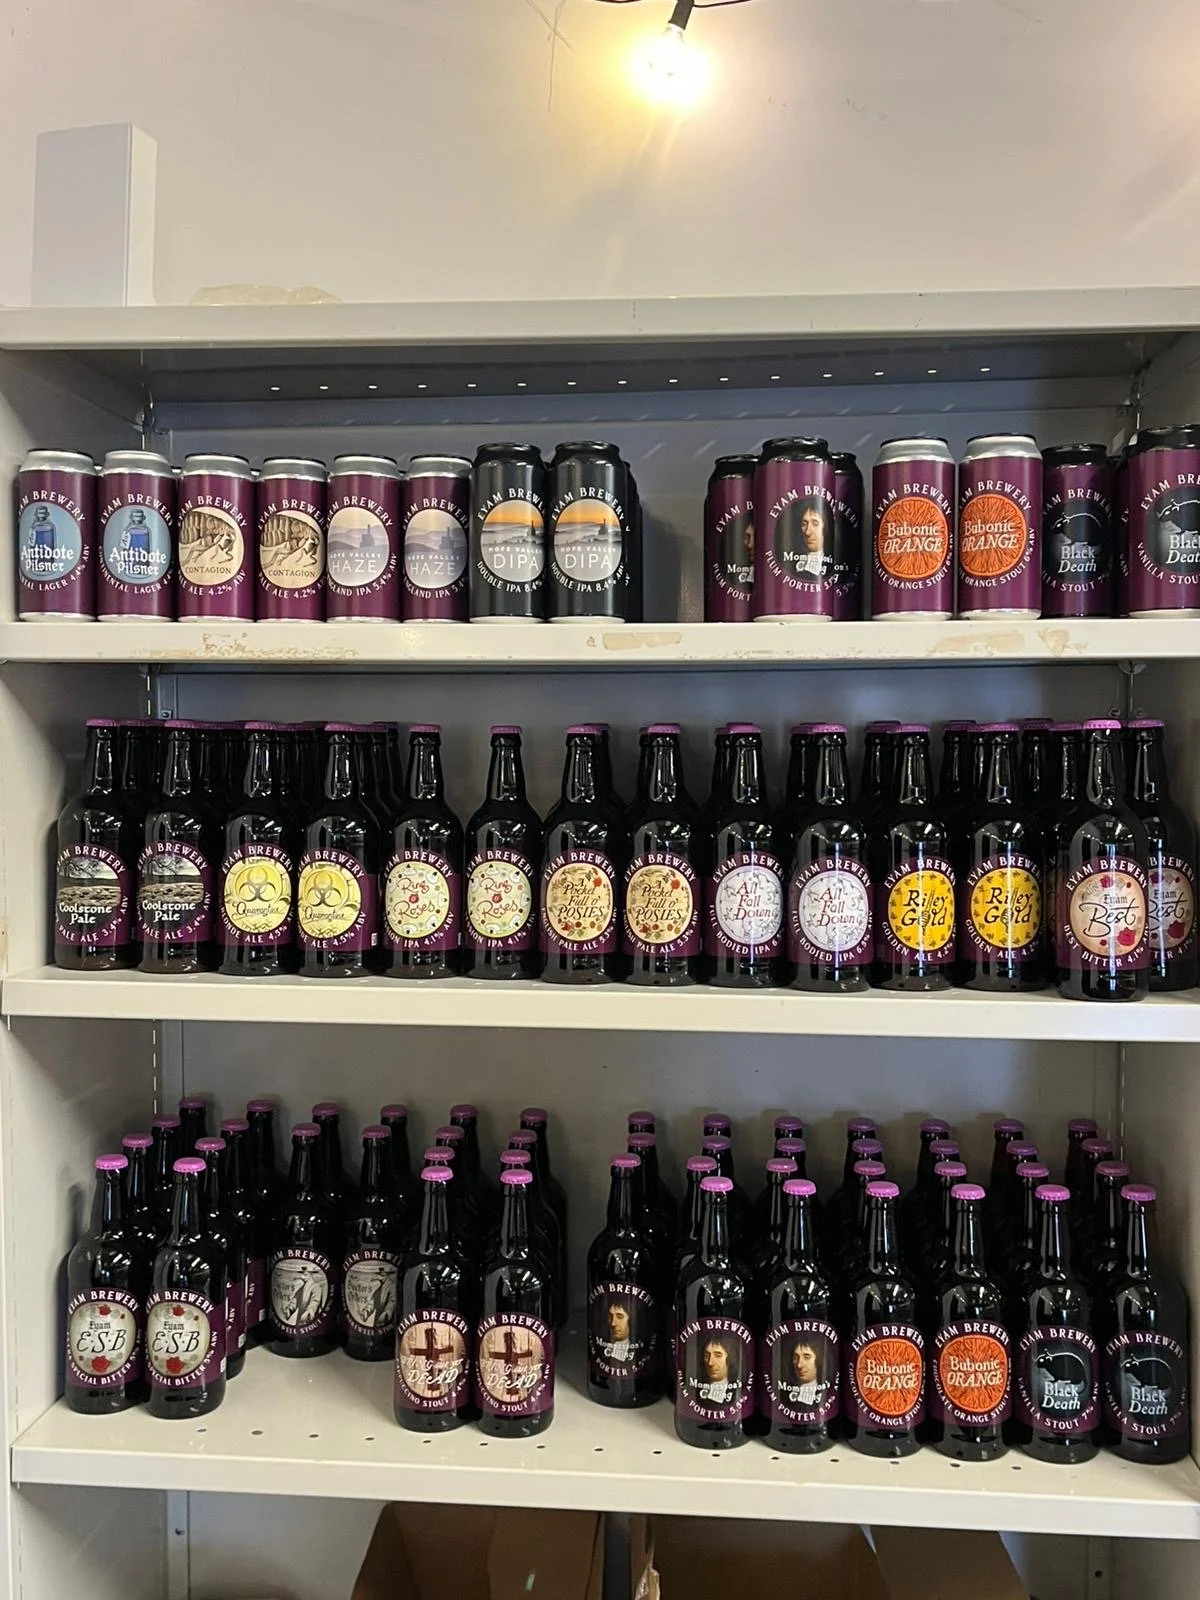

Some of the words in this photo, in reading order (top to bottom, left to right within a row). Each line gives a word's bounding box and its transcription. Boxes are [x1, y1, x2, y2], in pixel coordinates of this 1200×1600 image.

[552, 491, 574, 521] EYAM
[580, 486, 625, 521] BREWERY
[769, 488, 799, 519] EYAM
[875, 489, 897, 520] EYAM
[903, 483, 951, 516] BREWERY
[977, 480, 1032, 511] BREWERY
[1140, 478, 1171, 511] EYAM
[33, 489, 86, 522] BREWERY
[198, 496, 248, 527] BREWERY
[344, 496, 393, 527] BREWERY
[477, 491, 503, 521] EYAM
[715, 504, 741, 534] EYAM
[964, 520, 1016, 536] Bubonic
[886, 521, 940, 538] Bubonic
[21, 545, 74, 560] Antidote
[883, 536, 944, 554] ORANGE
[962, 534, 1020, 553] ORANGE
[1060, 545, 1096, 560] Black
[109, 547, 168, 563] Antidote
[494, 553, 540, 571] DIPA
[565, 553, 613, 570] DIPA
[1137, 542, 1164, 580] VANILLA
[25, 559, 65, 572] Pilsner
[117, 561, 160, 576] Pilsner
[185, 566, 232, 575] CONTAGION
[268, 569, 317, 578] CONTAGION
[332, 559, 377, 573] HAZE
[410, 561, 457, 575] HAZE
[765, 550, 783, 577] PLUM
[782, 575, 822, 593] PORTER
[1000, 564, 1025, 584] STOUT
[1057, 559, 1098, 574] Death
[477, 560, 502, 590] DOUBLE
[552, 561, 575, 590] DOUBLE
[888, 577, 924, 590] ORANGE
[39, 581, 68, 591] LAGER
[134, 583, 162, 594] LAGER
[1060, 581, 1096, 593] STOUT
[74, 844, 126, 874] BREWERY
[157, 841, 209, 871] BREWERY
[248, 845, 294, 873] BREWERY
[315, 850, 365, 879] BREWERY
[404, 850, 453, 879] BREWERY
[487, 850, 534, 878] BREWERY
[544, 855, 565, 881] EYAM
[570, 851, 617, 881] BREWERY
[623, 857, 644, 884] EYAM
[648, 853, 698, 884] BREWERY
[712, 858, 737, 884] EYAM
[795, 864, 820, 889] EYAM
[826, 859, 871, 888] BREWERY
[967, 859, 993, 887] EYAM
[1066, 862, 1093, 891] EYAM
[1100, 859, 1148, 890] BREWERY
[884, 862, 911, 889] EYAM
[563, 881, 597, 896] Pocket
[641, 882, 674, 898] Pocket
[736, 881, 759, 895] All
[820, 887, 843, 901] All
[59, 901, 113, 915] Coolstone
[142, 900, 197, 913] Coolstone
[738, 894, 761, 907] Fall
[822, 900, 846, 914] Fall
[69, 912, 97, 925] Pale
[153, 909, 181, 923] Pale
[557, 906, 605, 921] POSIES
[634, 908, 684, 923] POSIES
[735, 907, 772, 921] Down
[819, 913, 856, 927] Down
[1079, 898, 1139, 938] Best
[80, 931, 99, 943] ALE
[165, 930, 184, 941] ALE
[245, 936, 263, 944] ALE
[311, 939, 328, 949] ALE
[404, 938, 420, 947] IPA
[488, 938, 503, 947] IPA
[558, 938, 578, 951] PALE
[582, 939, 598, 951] ALE
[716, 930, 749, 956] BODIED
[755, 946, 771, 955] IPA
[881, 921, 908, 957] GOLDEN
[965, 918, 992, 953] GOLDEN
[1063, 924, 1079, 949] BEST
[636, 941, 659, 954] PALE
[660, 942, 676, 954] ALE
[799, 936, 833, 963] BODIED
[839, 952, 855, 962] IPA
[288, 1249, 332, 1272] BREWERY
[91, 1290, 139, 1312] BREWERY
[165, 1291, 214, 1315] BREWERY
[422, 1310, 469, 1335] BREWERY
[502, 1314, 550, 1339] BREWERY
[680, 1320, 701, 1344] EYAM
[706, 1319, 753, 1345] BREWERY
[765, 1323, 790, 1347] EYAM
[794, 1321, 839, 1346] BREWERY
[851, 1328, 877, 1351] EYAM
[881, 1326, 924, 1349] BREWERY
[934, 1325, 958, 1348] EYAM
[964, 1322, 1010, 1346] BREWERY
[1019, 1329, 1044, 1352] EYAM
[1049, 1328, 1097, 1354] BREWERY
[1105, 1333, 1130, 1356] EYAM
[1135, 1333, 1185, 1359] BREWERY
[596, 1358, 628, 1377] PORTER
[865, 1359, 916, 1375] Bubonic
[949, 1356, 1000, 1371] Bubonic
[101, 1364, 132, 1385] BITTER
[175, 1366, 206, 1386] BITTER
[407, 1368, 460, 1386] DEAD
[486, 1373, 540, 1390] DEAD
[862, 1374, 919, 1391] ORANGE
[946, 1370, 1004, 1388] ORANGE
[1043, 1381, 1079, 1397] Black
[1131, 1386, 1167, 1402] Black
[422, 1397, 450, 1408] STOUT
[502, 1401, 528, 1412] STOUT
[689, 1400, 726, 1420] PORTER
[1018, 1377, 1041, 1420] VANILLA
[1044, 1417, 1081, 1430] STOUT
[1041, 1395, 1081, 1410] Death
[1127, 1400, 1169, 1415] Death
[778, 1403, 816, 1422] PORTER
[869, 1412, 904, 1426] ORANGE
[953, 1409, 989, 1423] ORANGE
[1131, 1422, 1167, 1435] STOUT
